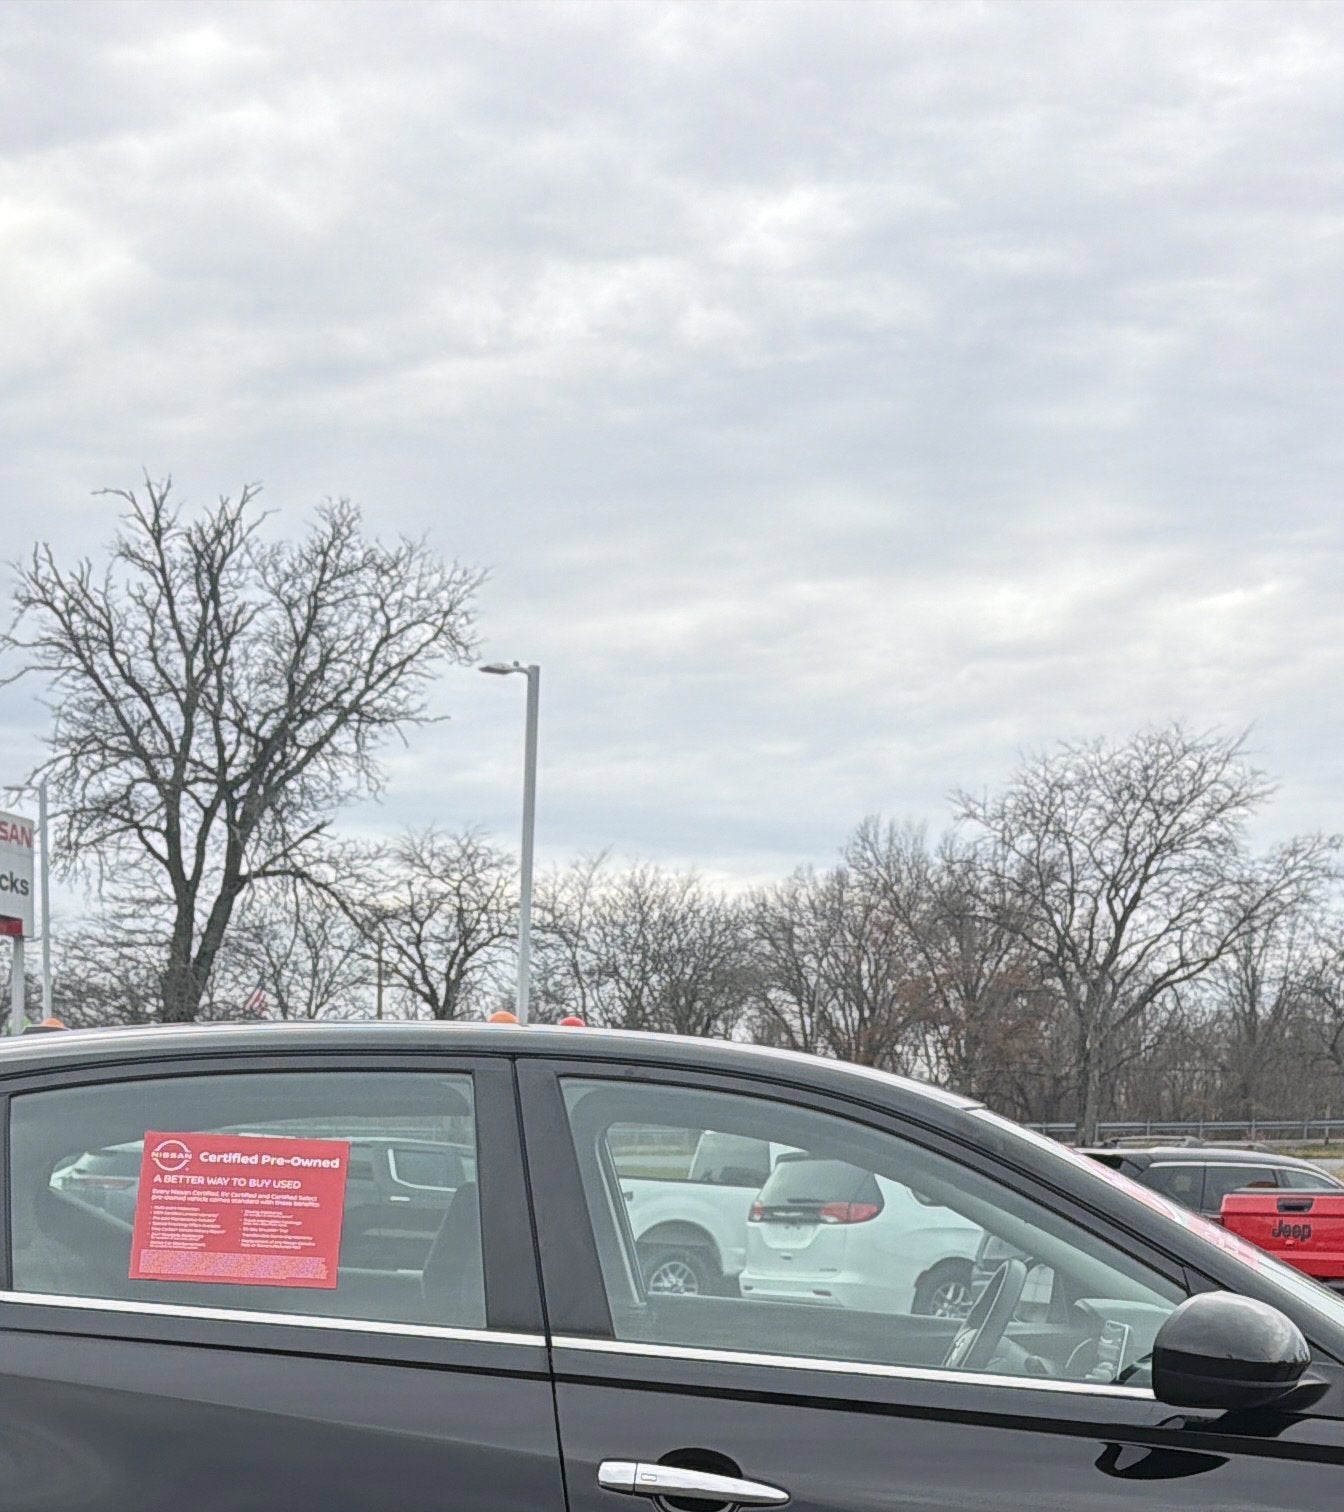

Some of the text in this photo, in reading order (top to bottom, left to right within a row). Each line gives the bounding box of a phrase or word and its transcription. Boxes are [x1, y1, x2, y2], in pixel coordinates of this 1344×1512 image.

[151, 1151, 192, 1160] NISSAN
[199, 1151, 340, 1168] Certified Pre-Owned
[153, 1174, 302, 1189] A BETTER WAY TO BUY USED
[1271, 1219, 1312, 1242] Jeep
